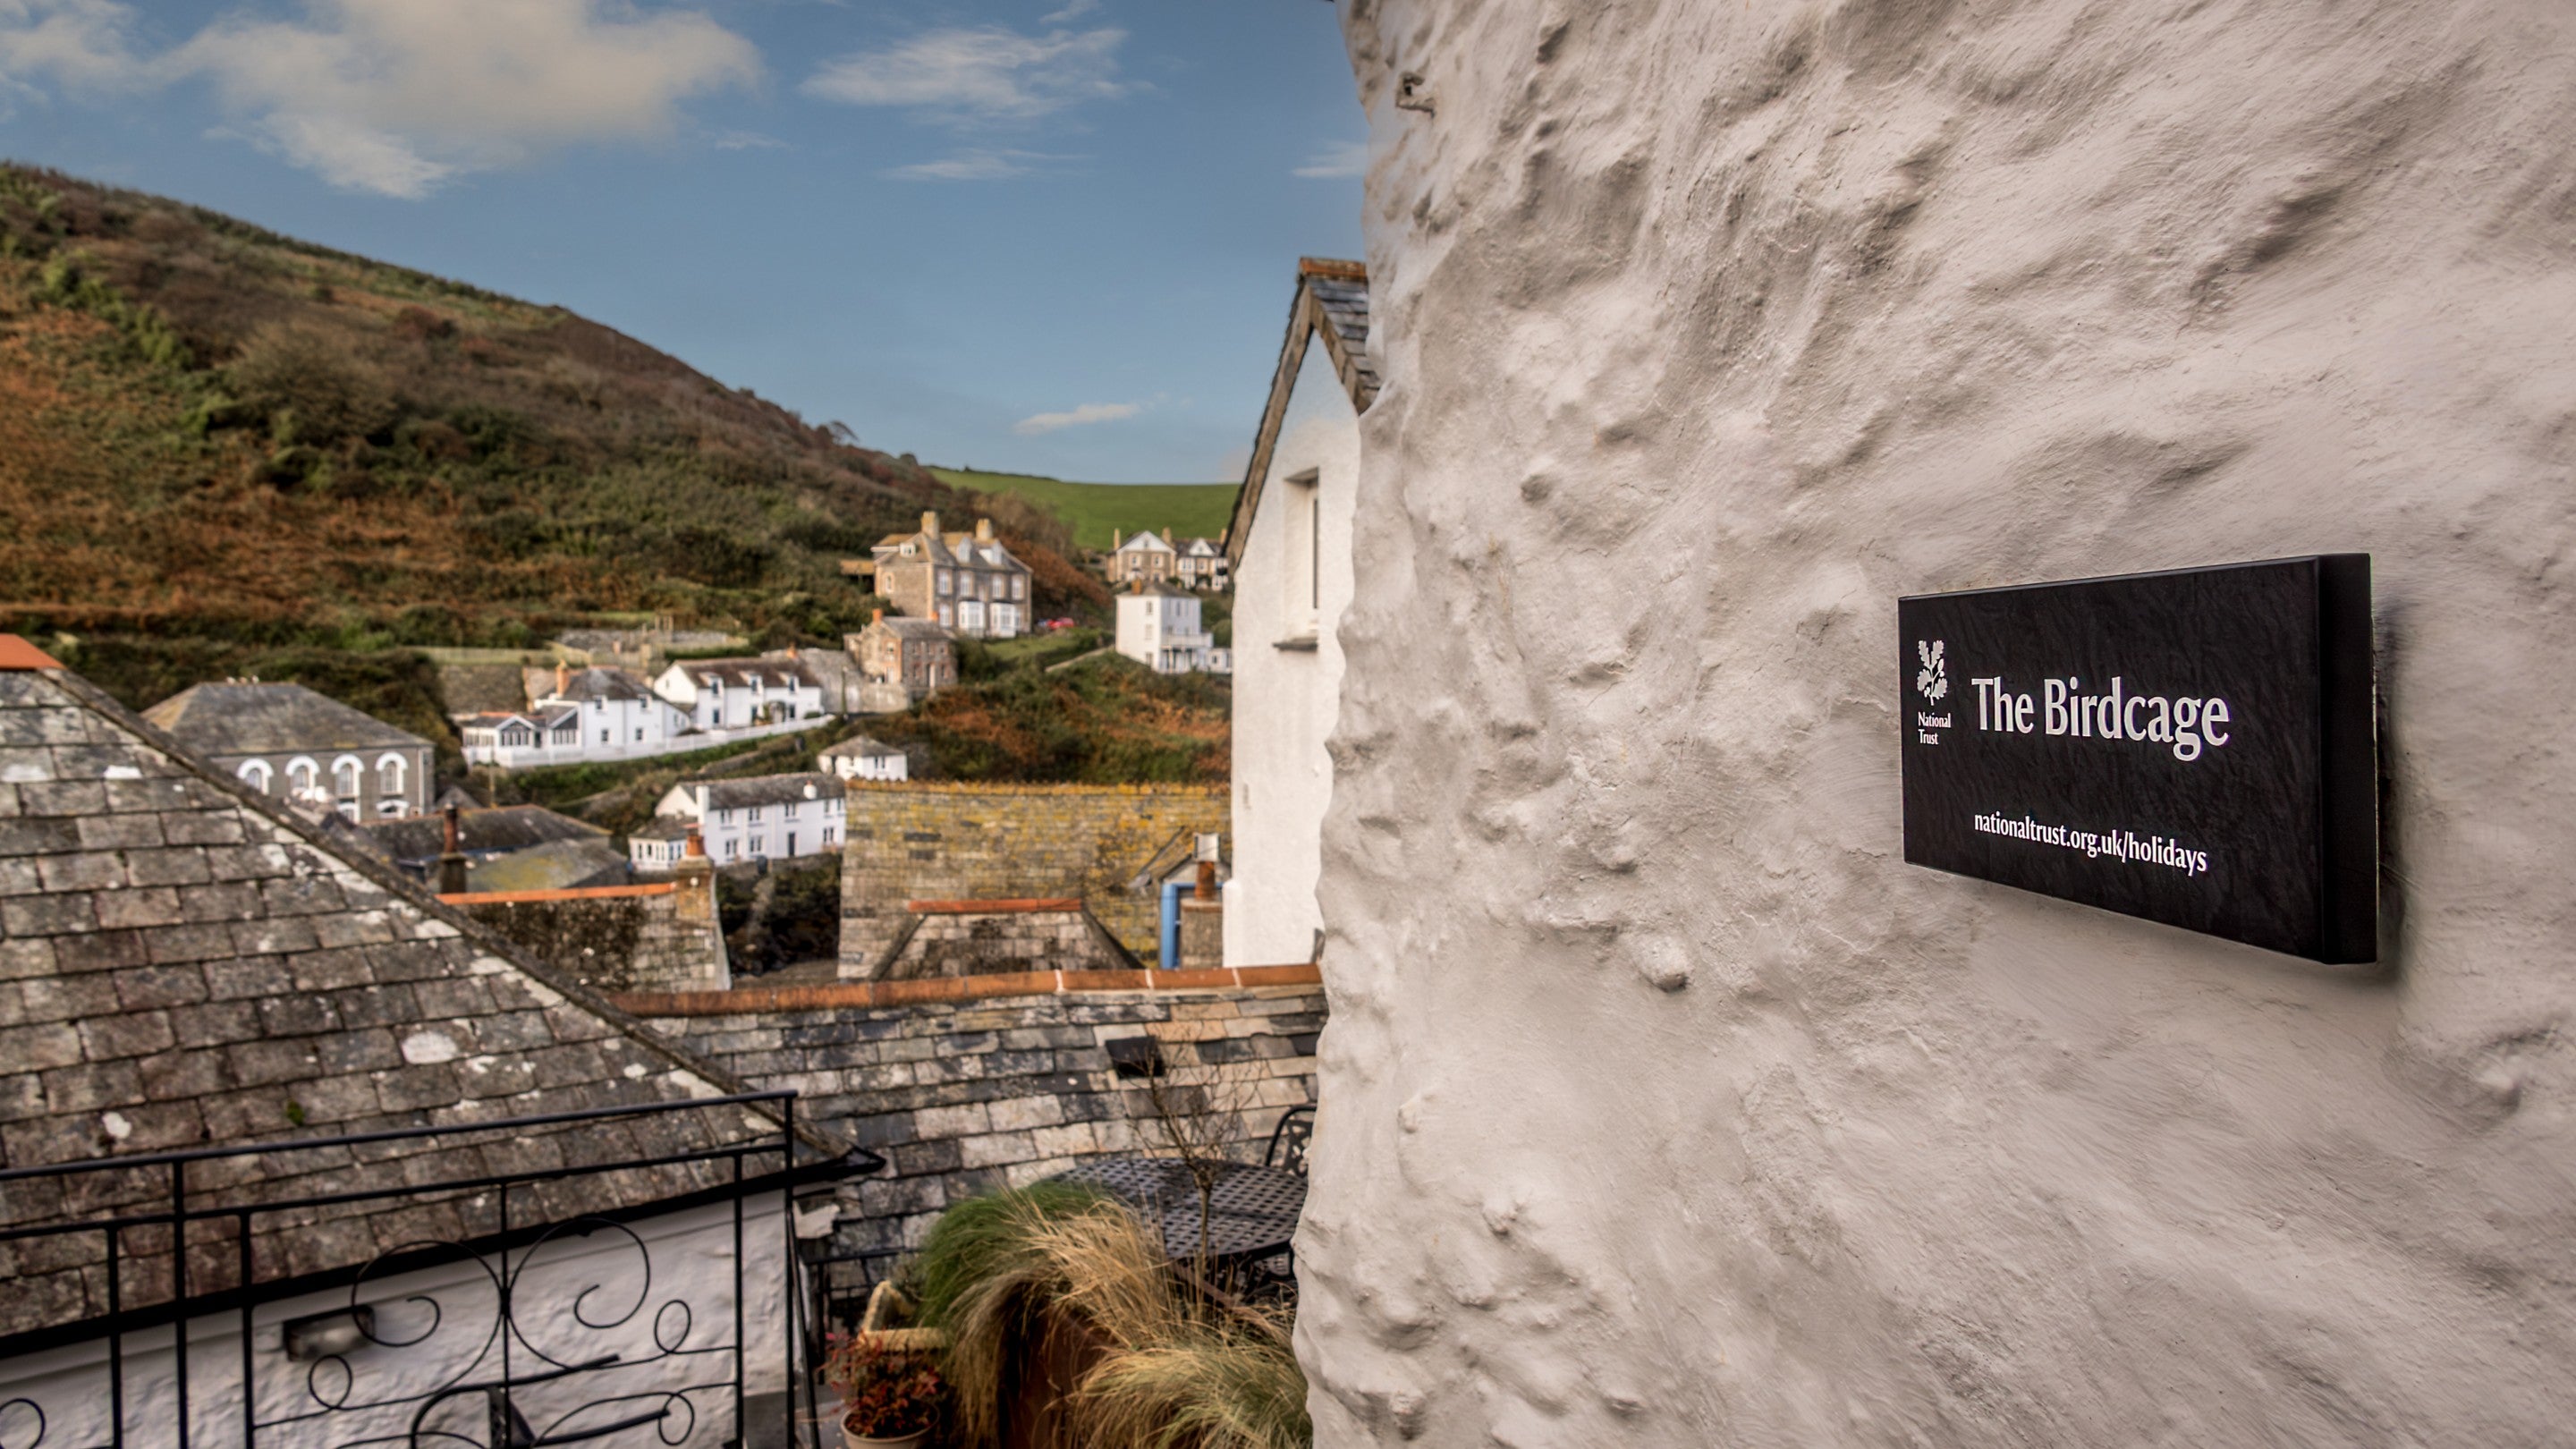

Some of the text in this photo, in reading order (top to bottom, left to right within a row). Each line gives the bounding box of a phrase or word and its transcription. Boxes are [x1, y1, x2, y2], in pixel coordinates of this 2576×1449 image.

[1918, 711, 1952, 728] National
[1918, 728, 1939, 745] Trust
[1970, 675, 2231, 762] The Birdcage
[1974, 810, 2207, 877] nationaltrust.org.uk/holidays
